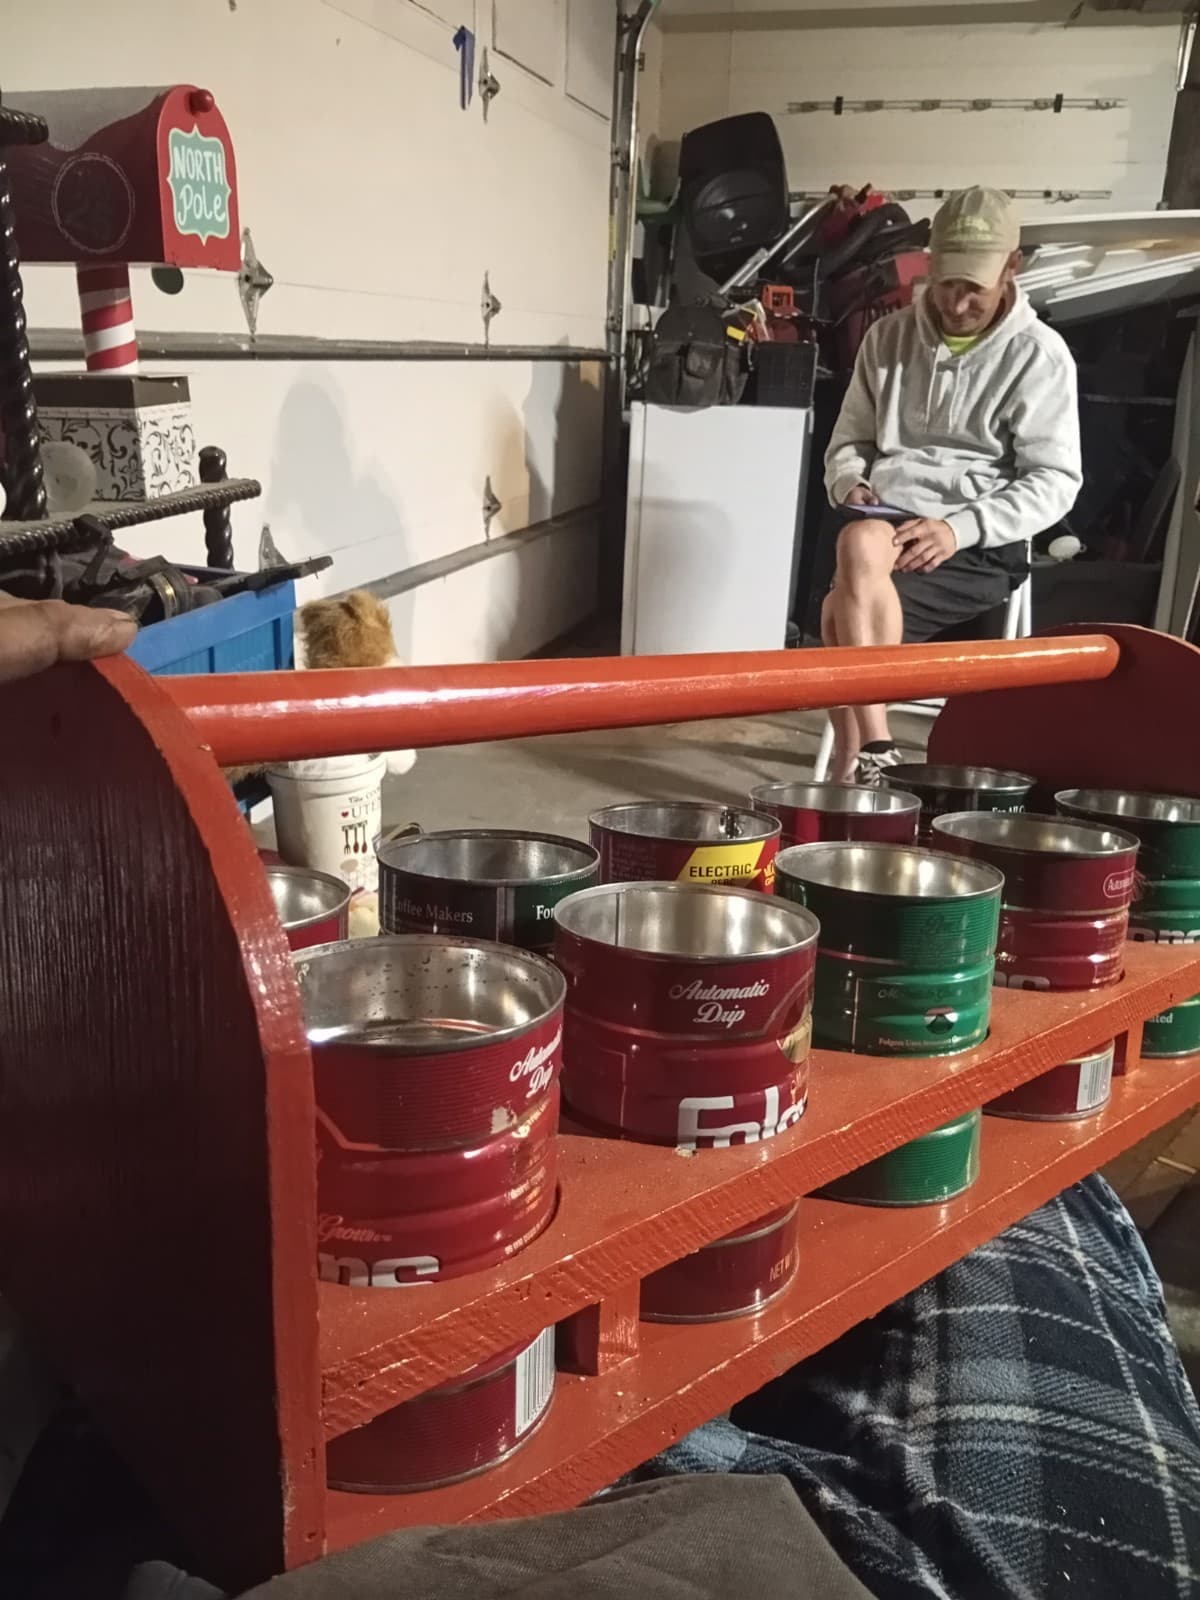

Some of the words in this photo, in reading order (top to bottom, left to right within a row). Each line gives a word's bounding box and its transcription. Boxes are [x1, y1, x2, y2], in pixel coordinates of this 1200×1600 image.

[173, 145, 224, 186] NORTH
[177, 183, 226, 226] Pole
[689, 863, 752, 877] ELECTRIC
[425, 903, 474, 923] Makers
[669, 979, 770, 1000] Automatic
[692, 1001, 746, 1029] Drip
[769, 1258, 784, 1282] NET
